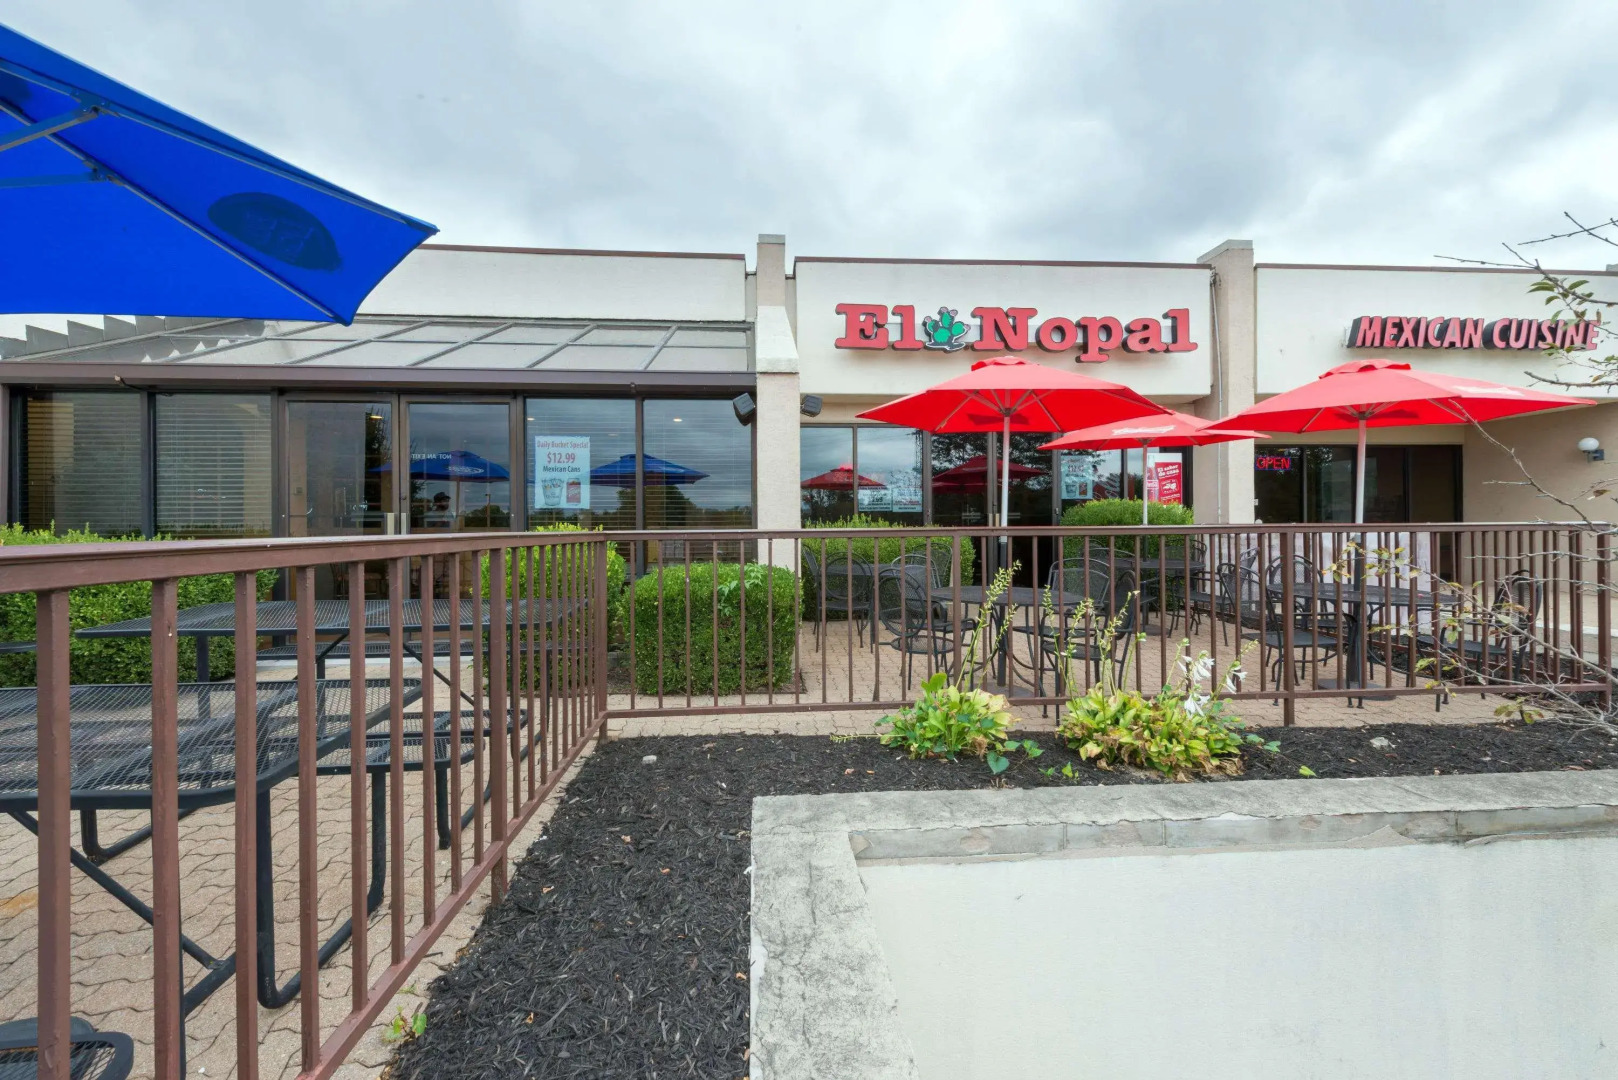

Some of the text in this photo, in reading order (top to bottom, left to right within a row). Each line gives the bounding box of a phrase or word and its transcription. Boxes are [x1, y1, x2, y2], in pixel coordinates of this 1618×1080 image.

[834, 303, 1199, 363] El Nopal
[1352, 316, 1600, 351] MEXICAN CUISINE
[537, 440, 551, 449] Daily
[569, 440, 589, 450] Special
[547, 452, 576, 464] $12.99
[1256, 457, 1291, 470] OPEN
[542, 465, 581, 473] Mexican Cans
